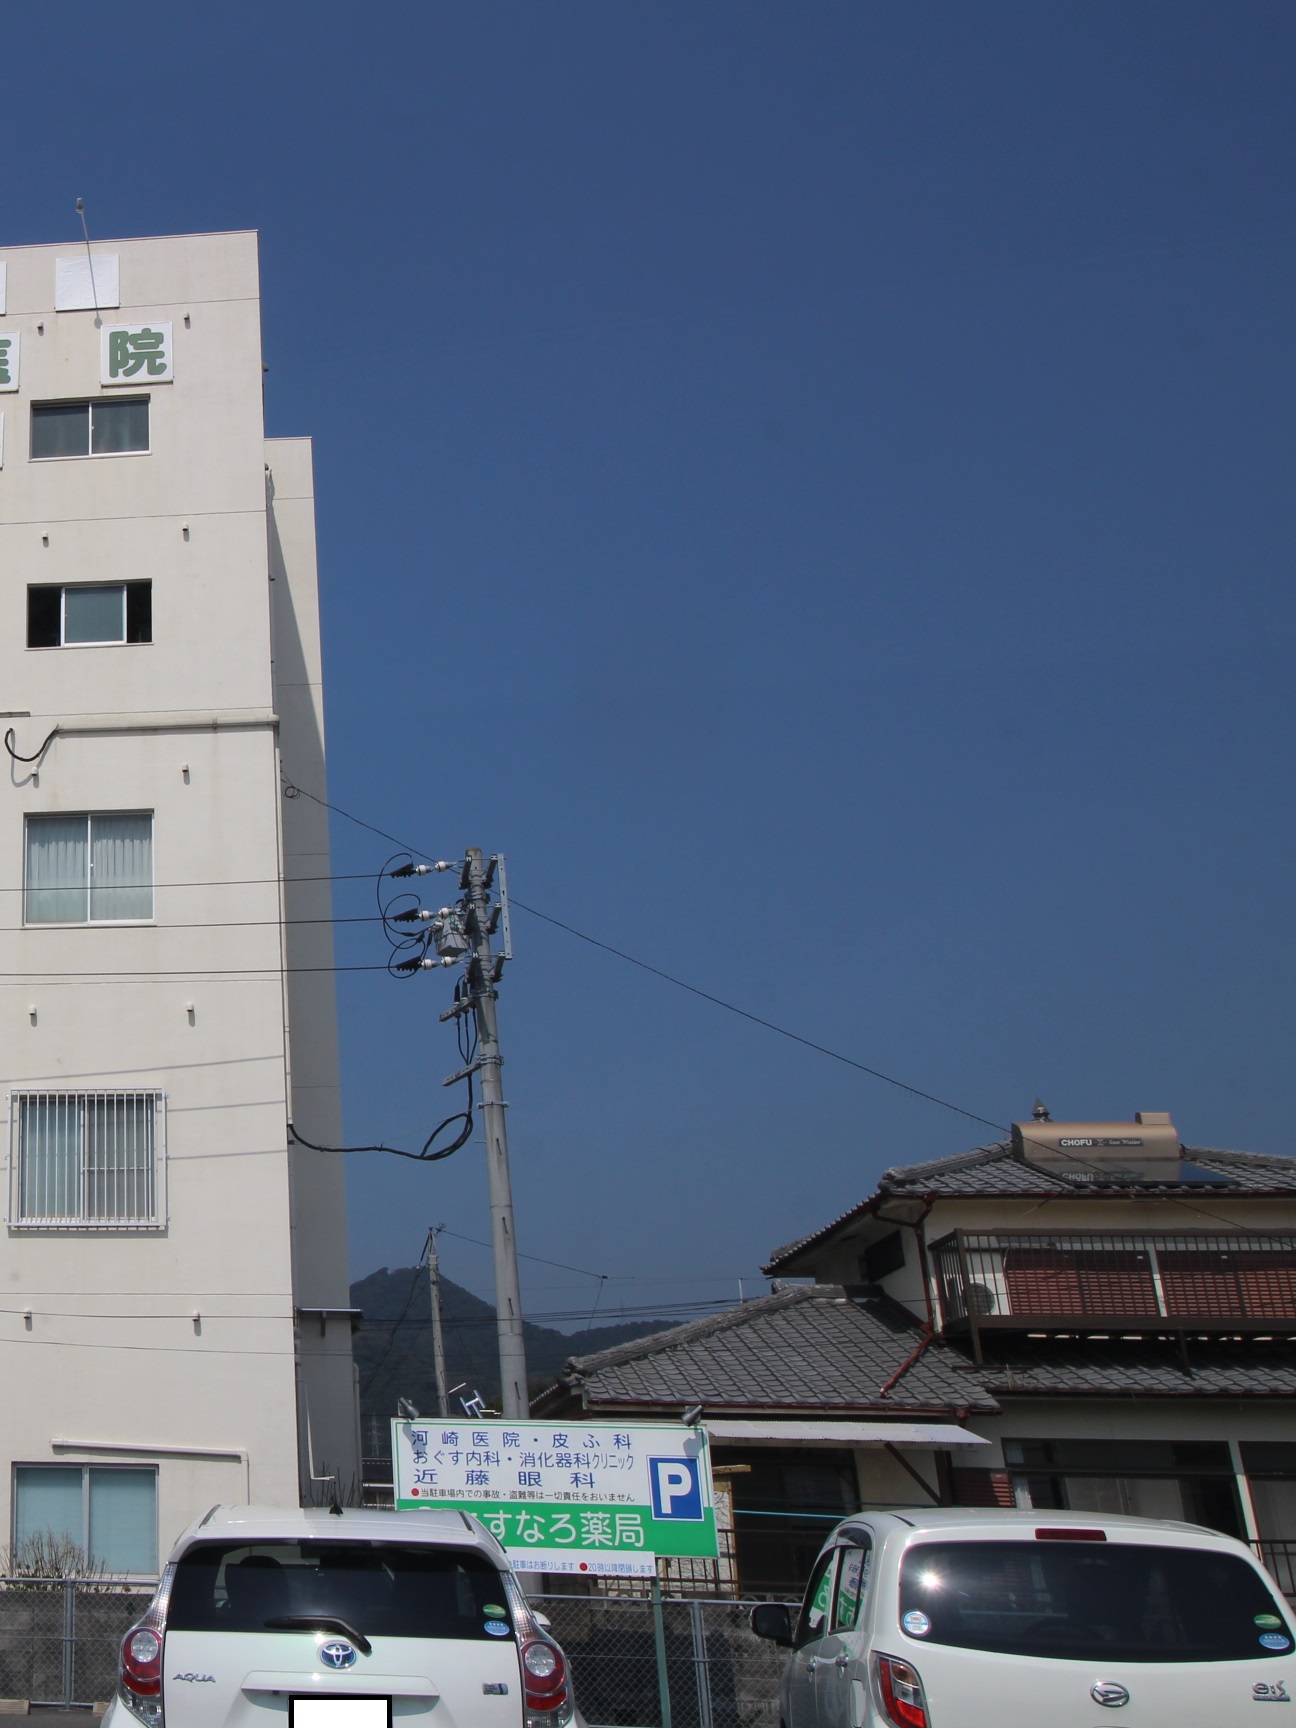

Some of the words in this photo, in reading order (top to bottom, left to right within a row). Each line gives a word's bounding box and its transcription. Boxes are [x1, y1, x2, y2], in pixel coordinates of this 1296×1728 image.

[657, 1462, 692, 1514] P
[472, 1510, 644, 1547] すなろ薬局
[172, 1672, 216, 1683] AQUA
